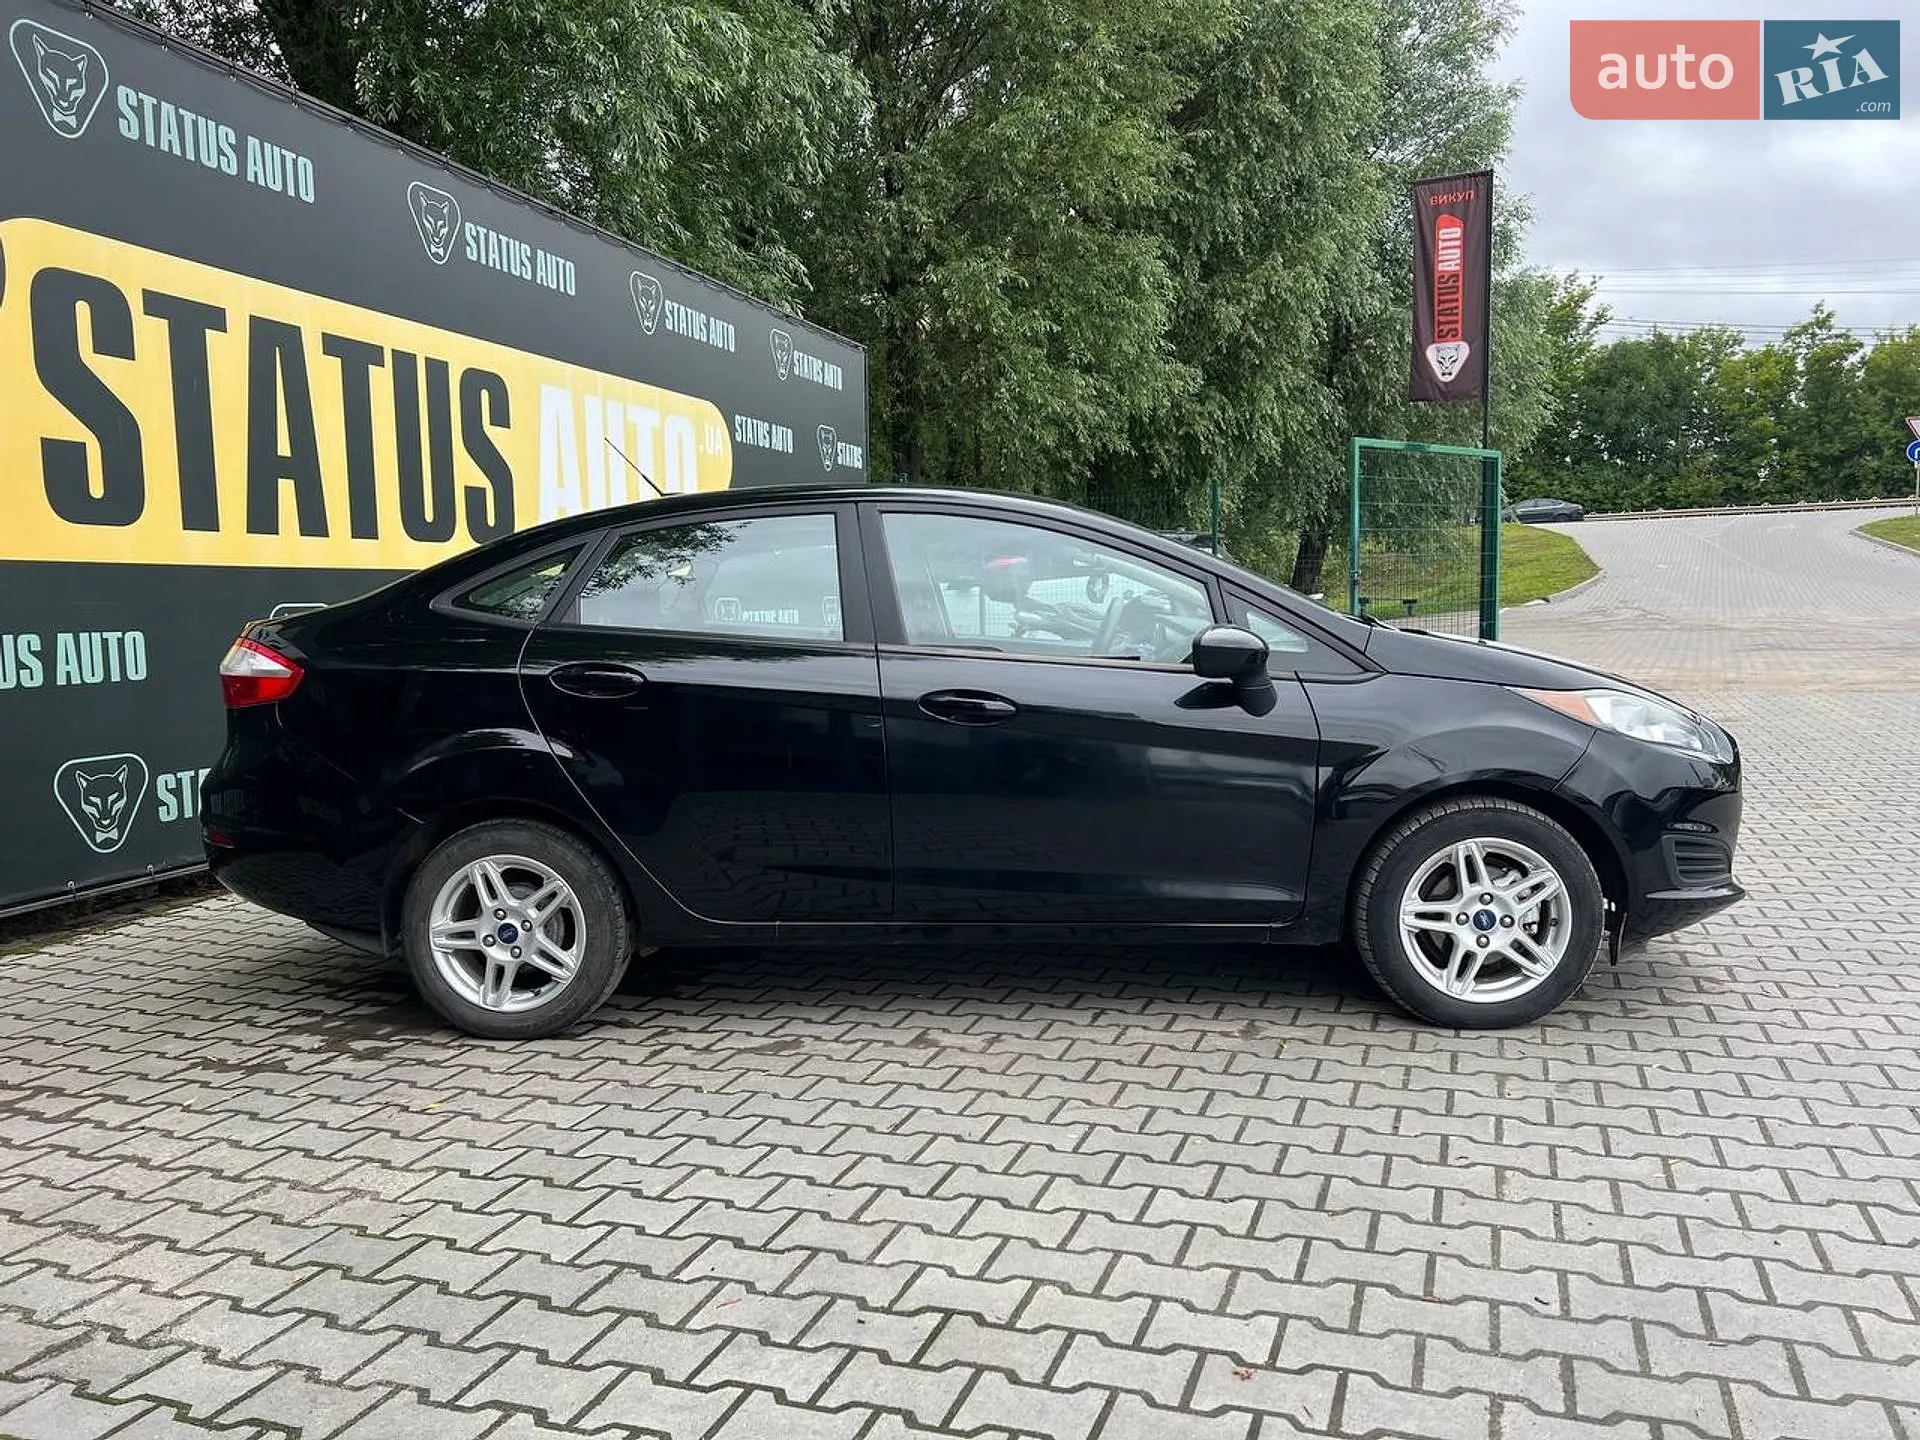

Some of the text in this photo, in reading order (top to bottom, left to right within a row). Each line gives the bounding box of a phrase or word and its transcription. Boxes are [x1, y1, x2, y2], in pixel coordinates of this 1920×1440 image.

[117, 85, 315, 204] STATUS AUTO
[464, 221, 576, 297] STATUS AUTO
[1437, 227, 1462, 339] STATUS AUTO
[664, 299, 736, 353] STATUS AUTO
[793, 349, 842, 391] STATUS AUTO
[30, 266, 516, 544] STATUS
[735, 414, 793, 454] STATUS AUTO
[837, 441, 863, 470] STATUS
[56, 630, 148, 686] AUTO
